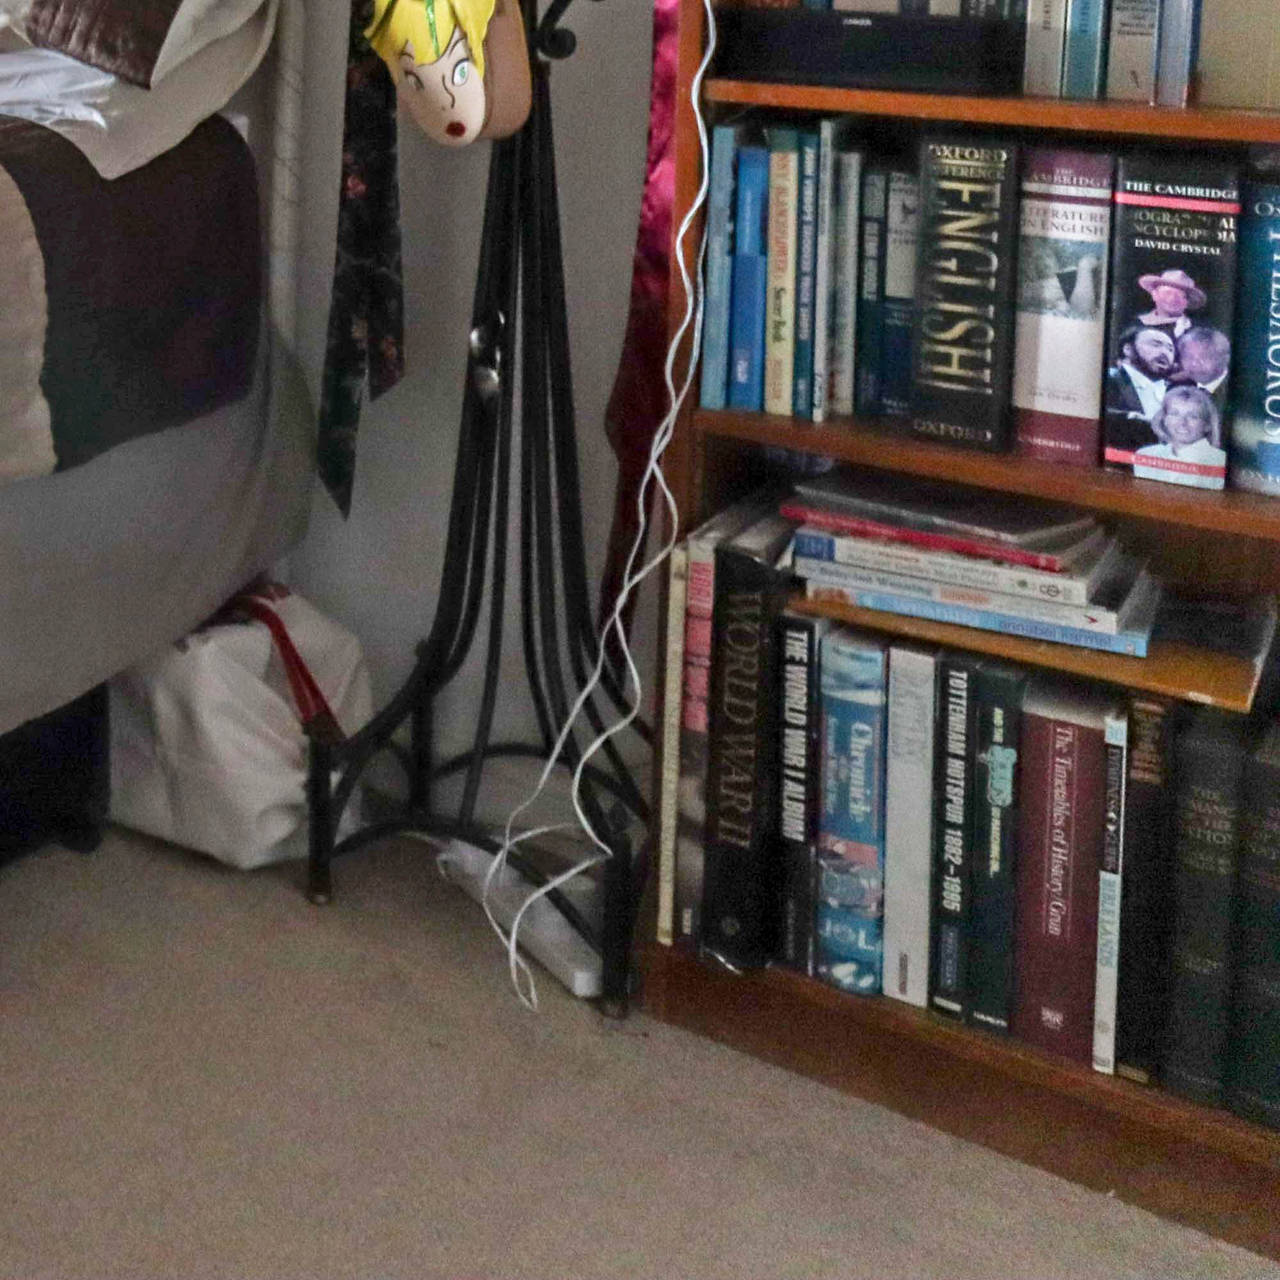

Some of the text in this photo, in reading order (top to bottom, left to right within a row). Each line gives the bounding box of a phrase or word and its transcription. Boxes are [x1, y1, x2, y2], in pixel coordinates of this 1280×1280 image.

[934, 166, 1005, 181] FERENCE
[1030, 172, 1108, 187] AMBRIDGE
[1125, 181, 1238, 200] THE CAMBRIDGE
[1026, 206, 1108, 223] ITERATURE
[1040, 220, 1105, 235] ENGLISH
[1134, 238, 1222, 257] DAVID CRYSTAL
[921, 181, 1002, 387] ENGLISH
[785, 630, 809, 664] THE
[784, 665, 808, 726] WORLD
[947, 671, 968, 756] TOTTENHAM
[717, 592, 762, 848] WORLD WAR II
[1055, 726, 1074, 753] The
[783, 728, 807, 768] WAR
[848, 721, 874, 823] Chronicle
[945, 757, 966, 825] HOTSPUR
[1053, 756, 1072, 826] Timetables
[782, 778, 806, 844] ALBUM
